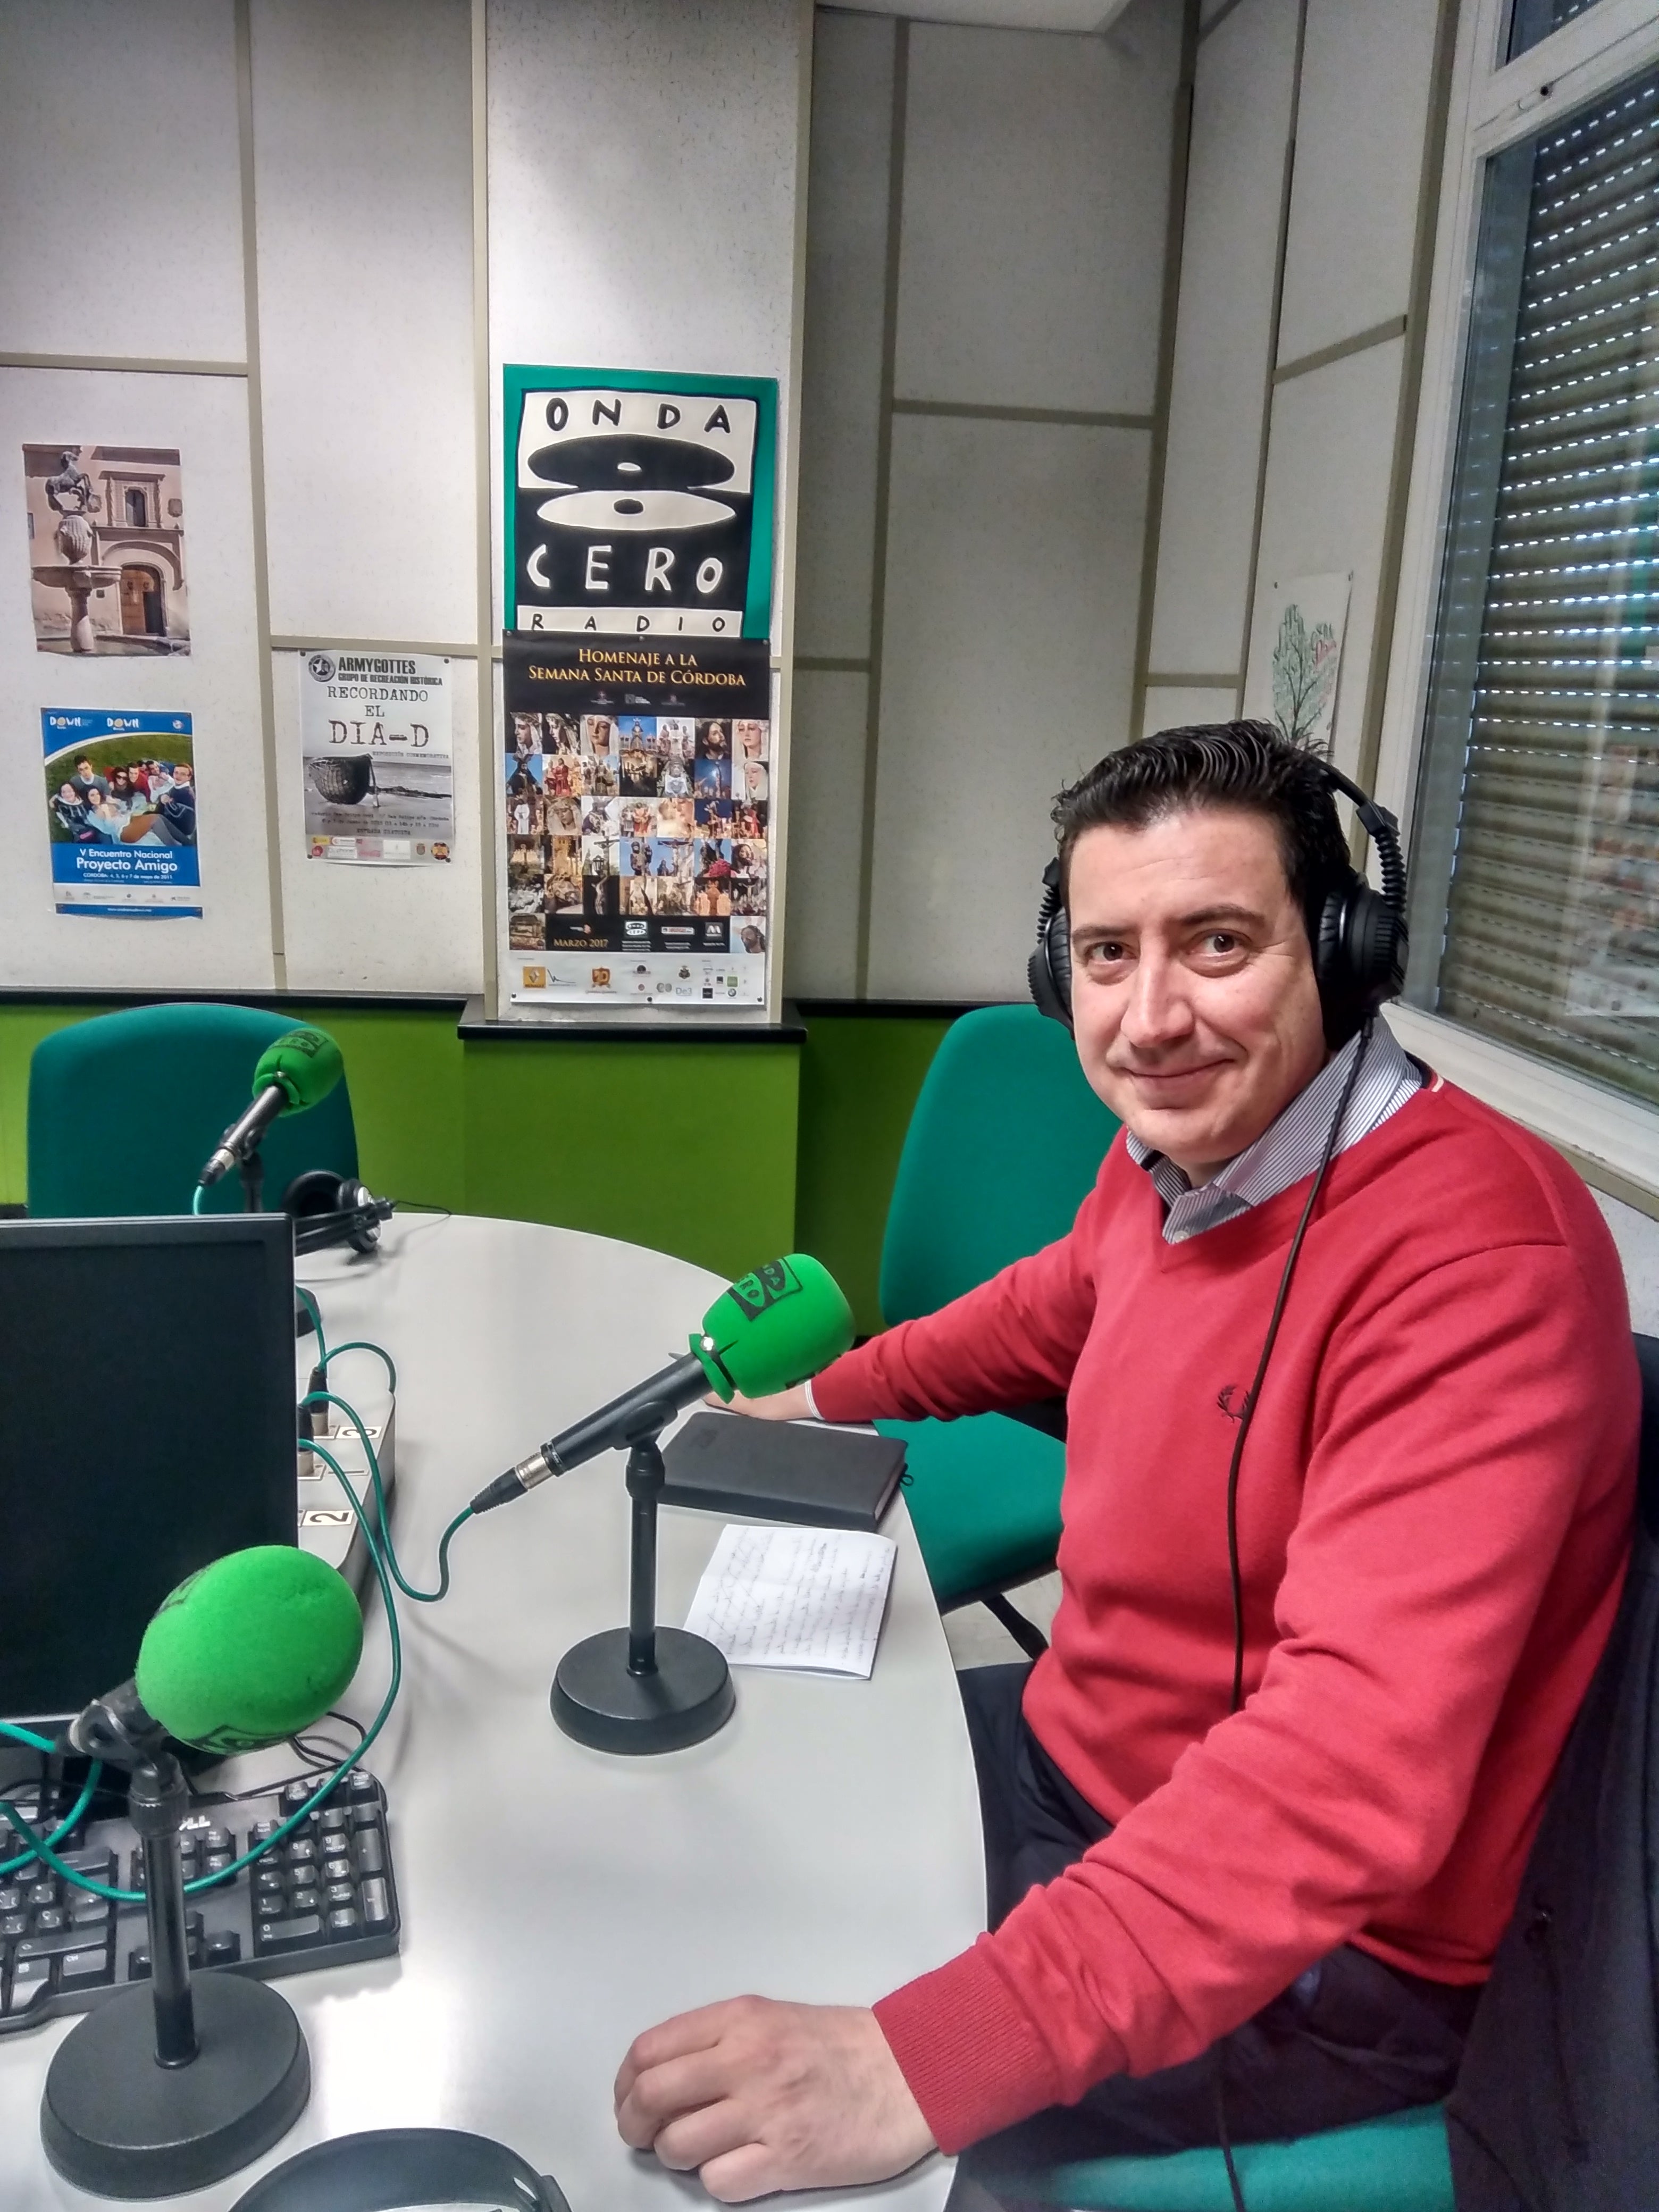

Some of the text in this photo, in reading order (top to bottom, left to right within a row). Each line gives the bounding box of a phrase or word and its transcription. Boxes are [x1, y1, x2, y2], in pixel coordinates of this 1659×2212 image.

[546, 397, 731, 433] ONDA
[526, 544, 723, 593] CERO
[532, 613, 726, 632] RADIO
[338, 657, 416, 675] ARMYGOTTES
[579, 648, 698, 667] HOMENAJE A LA
[338, 673, 359, 682] GRUPO
[361, 674, 368, 683] DE
[528, 665, 746, 686] SEMANA SANTA DE CÓRDOBA
[327, 686, 429, 702] RECORDANDO
[365, 705, 385, 717] EL
[89, 849, 132, 858] Encuentro
[134, 850, 173, 859] Nacional
[76, 857, 178, 874] Proyecto Amigo
[554, 939, 609, 949] MARZO 2017
[309, 1512, 349, 1523] 2
